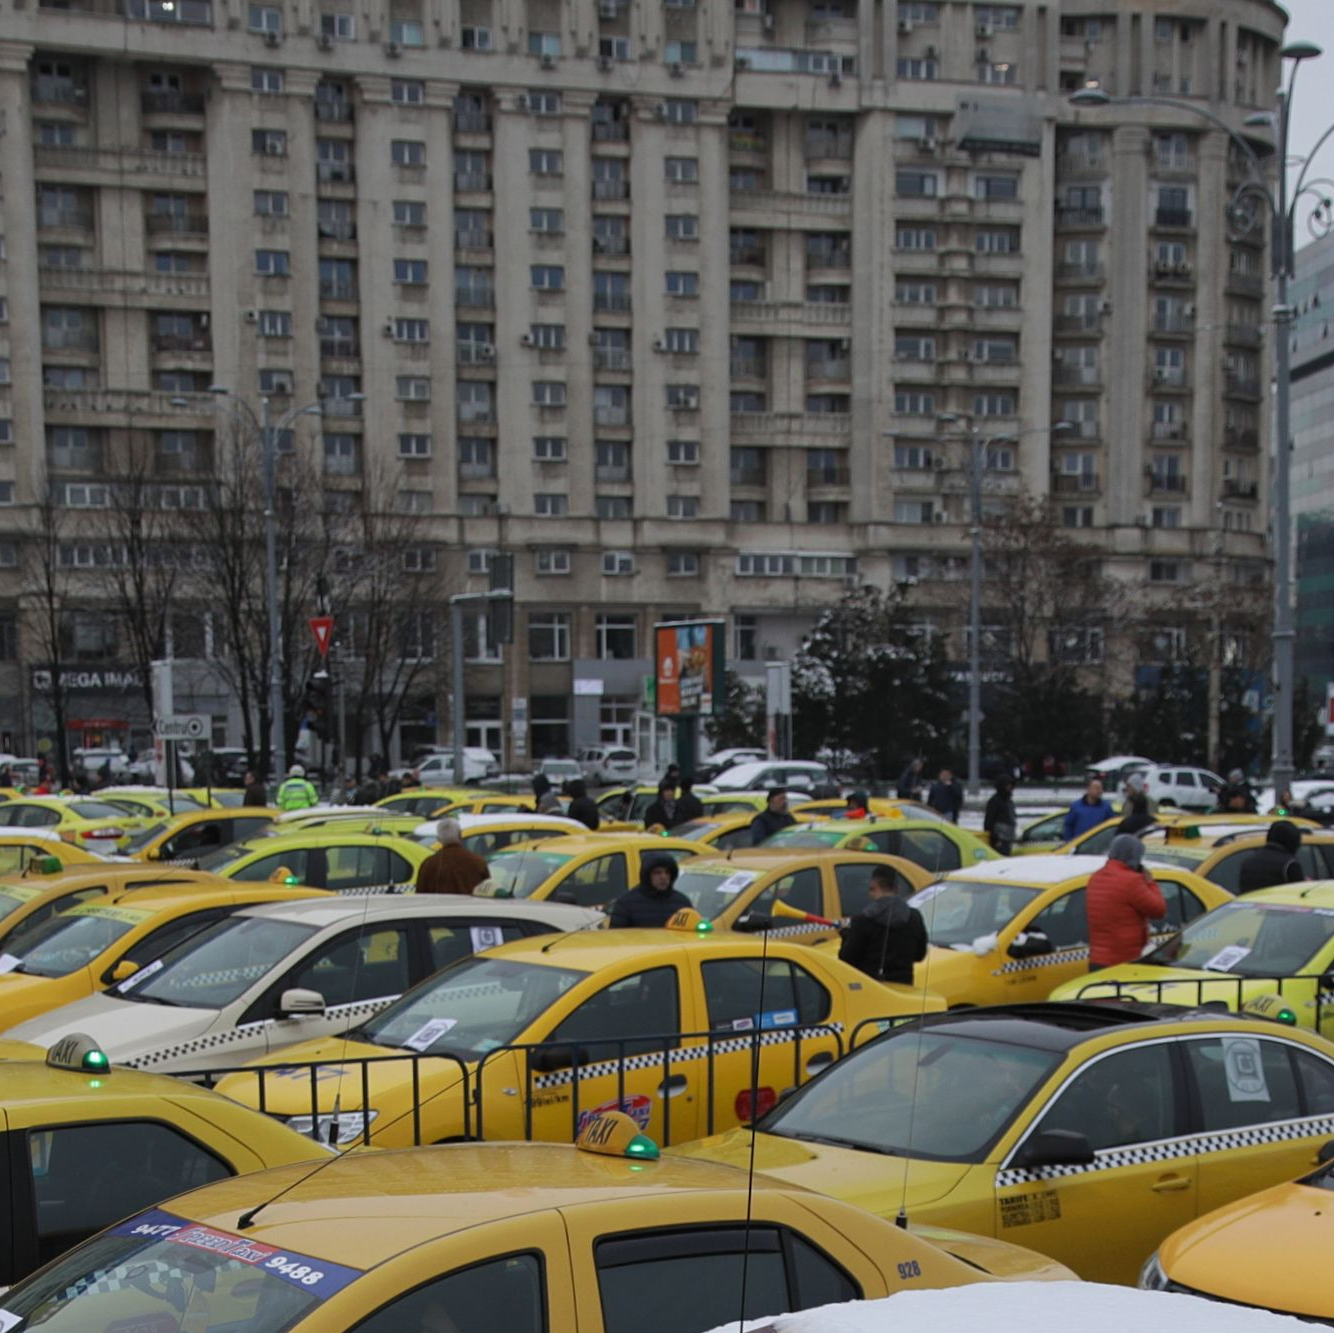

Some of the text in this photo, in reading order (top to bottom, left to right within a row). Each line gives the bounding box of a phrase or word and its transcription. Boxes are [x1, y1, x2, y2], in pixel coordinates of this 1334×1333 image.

[586, 1118, 618, 1145] TAXI
[131, 1224, 181, 1236] 9477
[265, 1256, 324, 1285] 9488
[897, 1260, 921, 1280] 928
